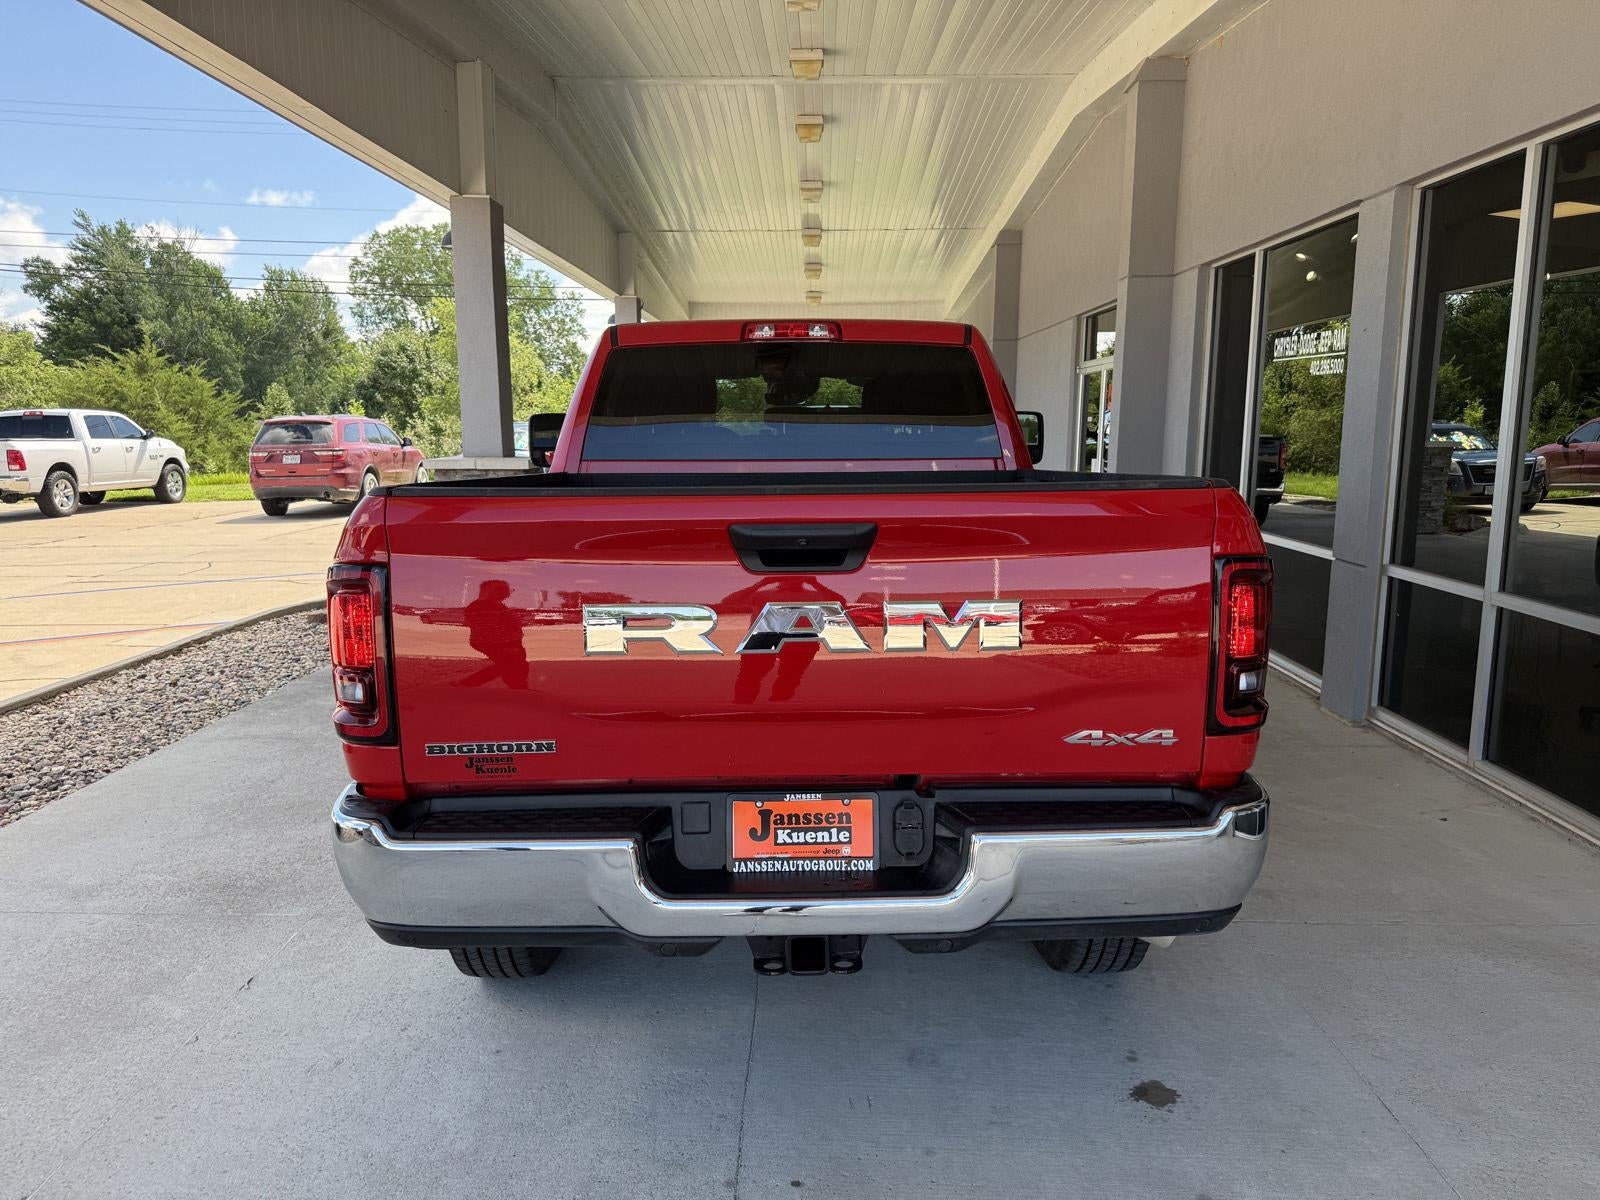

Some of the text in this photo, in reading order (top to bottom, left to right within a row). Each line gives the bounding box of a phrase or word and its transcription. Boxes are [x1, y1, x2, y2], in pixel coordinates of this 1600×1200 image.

[1333, 328, 1347, 350] RAM
[582, 600, 1024, 656] RAM
[425, 740, 556, 756] BIGHORN
[465, 756, 514, 768] Janssen
[475, 764, 518, 774] Kuenle
[784, 793, 822, 802] JANSSEN
[749, 809, 852, 842] Janssen
[776, 827, 850, 844] Kuenle
[822, 847, 840, 855] Jeep
[732, 859, 874, 873] JANSSENAUTOGROUP.COM
